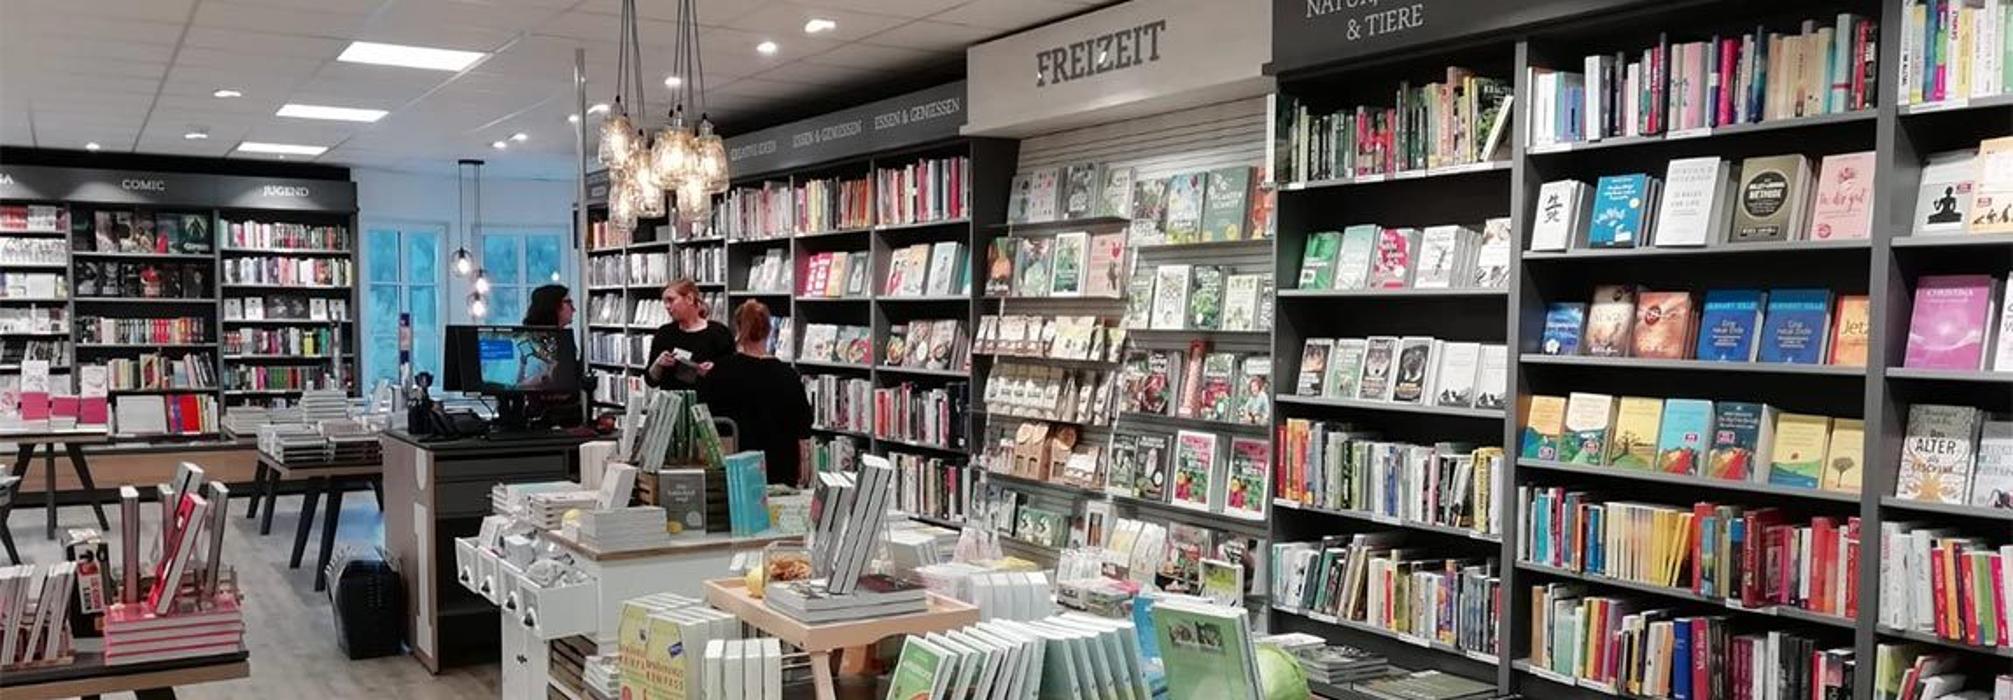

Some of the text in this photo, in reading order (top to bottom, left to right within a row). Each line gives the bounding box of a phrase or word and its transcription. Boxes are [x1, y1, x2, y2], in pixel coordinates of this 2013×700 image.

[1346, 4, 1424, 40] & TIERE
[1036, 19, 1166, 87] FREIZEIT
[874, 111, 901, 131] ESSEN
[909, 98, 960, 122] GENIESSEN
[122, 178, 166, 192] COMIC
[263, 184, 310, 198] JUGEND
[1914, 437, 1957, 455] ALTER
